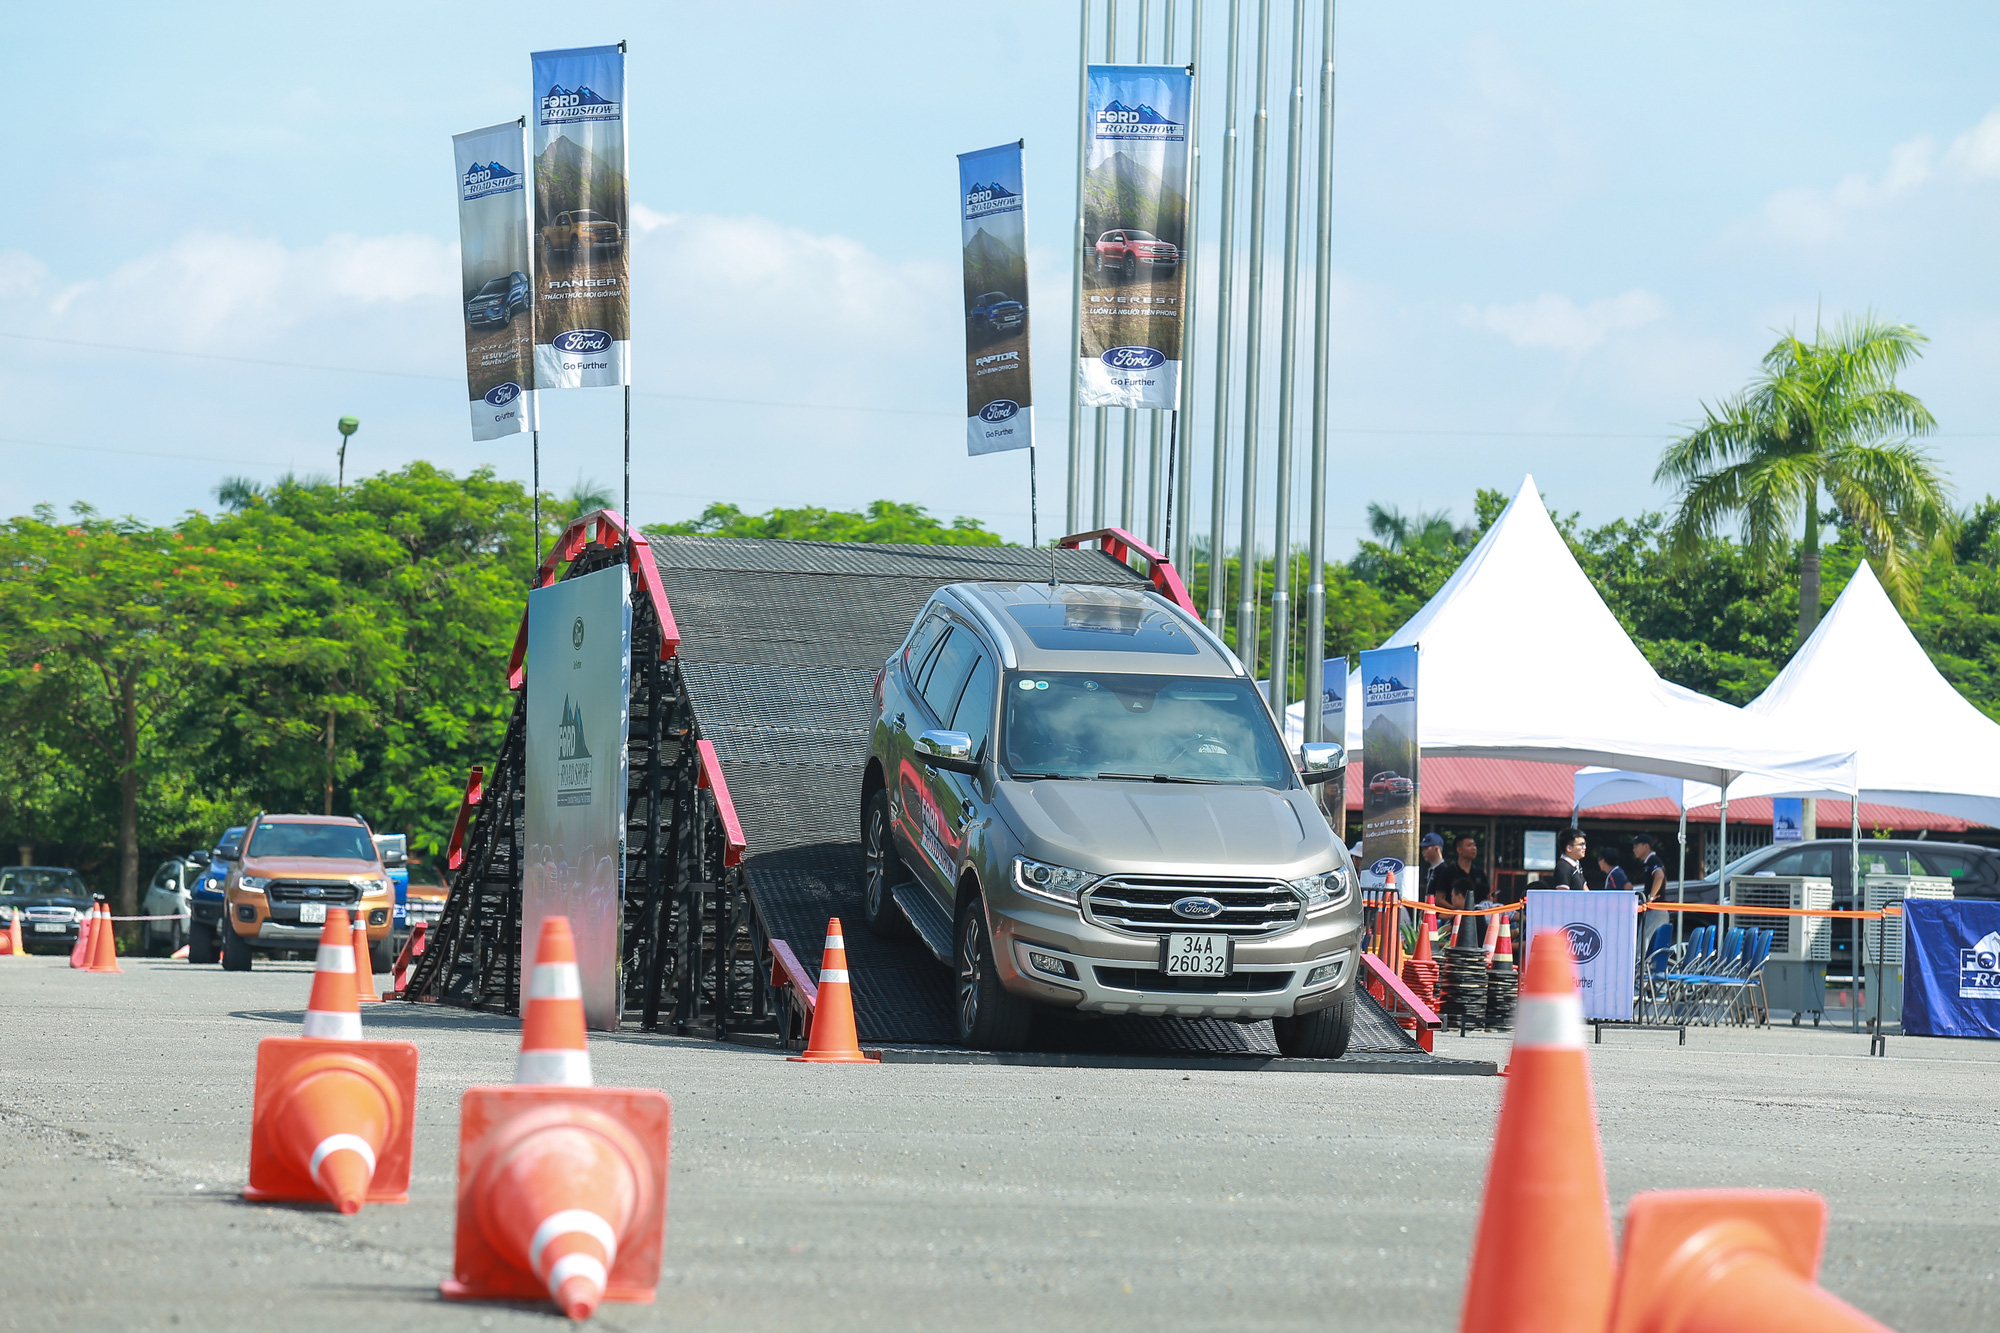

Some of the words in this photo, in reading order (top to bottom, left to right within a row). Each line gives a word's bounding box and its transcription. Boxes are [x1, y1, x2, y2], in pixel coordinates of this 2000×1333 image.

[542, 94, 580, 108] FORD
[548, 106, 613, 118] ROADSHOW
[1096, 111, 1140, 122] FORD
[1105, 124, 1176, 134] ROADSHOW
[464, 170, 491, 185] FORD
[966, 190, 992, 204] FORD
[972, 198, 1016, 212] ROADSHOW
[549, 278, 616, 288] RANGER
[1090, 296, 1177, 304] EVEREST
[565, 333, 604, 350] Ford
[976, 351, 1021, 367] RAPTOR
[1114, 349, 1154, 366] Ford
[987, 402, 1011, 420] Ford
[995, 428, 1013, 437] Further
[1367, 683, 1391, 694] FORD
[560, 726, 576, 757] FORD
[922, 798, 939, 837] FORD
[1367, 818, 1413, 828] EVEREST
[1376, 860, 1396, 874] Ford
[1184, 902, 1210, 914] Ford
[1183, 937, 1212, 953] 34A
[1566, 930, 1592, 956] Ford
[1170, 955, 1224, 973] 260.32
